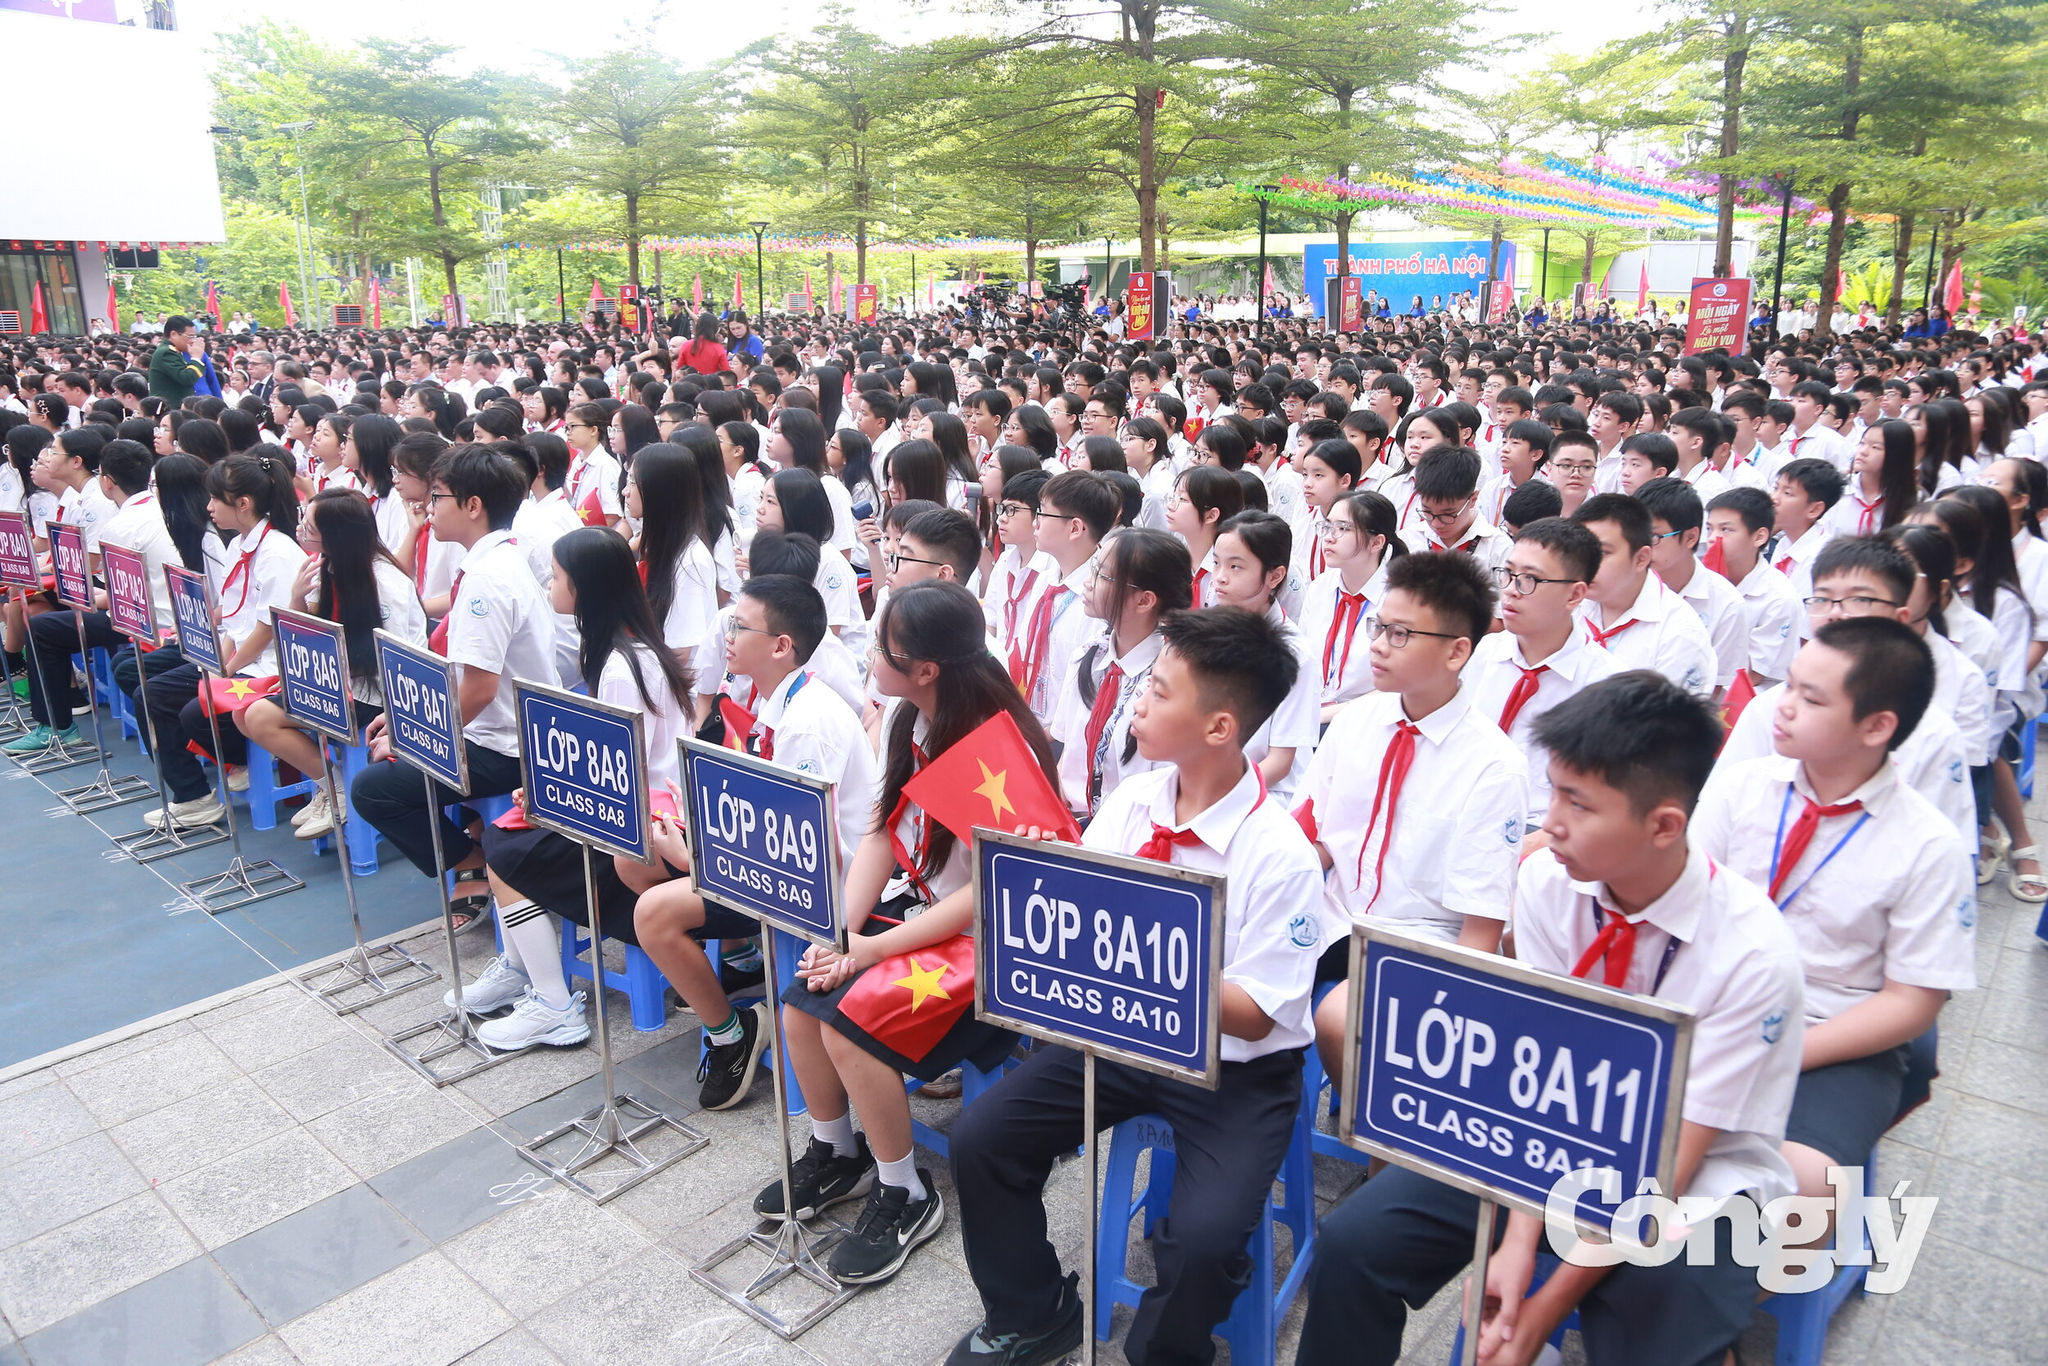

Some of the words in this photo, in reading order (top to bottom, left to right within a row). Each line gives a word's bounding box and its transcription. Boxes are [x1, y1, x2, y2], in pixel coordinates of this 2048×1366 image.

[1384, 251, 1422, 275] PHỐ
[1424, 254, 1450, 275] HÀ
[1452, 252, 1486, 279] NỘI
[1695, 304, 1714, 320] MỖI
[1714, 303, 1740, 318] NGÀY
[1693, 334, 1720, 349] NGÀY
[1720, 334, 1736, 346] VUI
[9, 533, 28, 558] 8A0
[54, 538, 70, 571] LỚP
[70, 545, 86, 575] 8A1
[1, 562, 19, 575] CLASS
[61, 578, 78, 593] CLASS
[110, 561, 129, 598] LỚP
[128, 573, 146, 605] 8A2
[119, 604, 137, 623] CLASS
[175, 585, 194, 625] LỚP
[193, 597, 211, 632] 8A3
[186, 631, 203, 650] CLASS
[203, 639, 215, 655] 8A3
[283, 634, 310, 681] LỚP
[312, 650, 339, 692] 8A6
[293, 688, 322, 711] CLASS
[323, 700, 340, 718] 8A6
[387, 664, 419, 716] LỚP
[421, 684, 448, 732] 8A7
[401, 721, 431, 750] CLASS
[432, 738, 449, 760] 8A7
[533, 717, 580, 777] LỚP
[586, 739, 629, 796] 8A8
[546, 784, 595, 816] CLASS
[598, 804, 626, 828] 8A8
[702, 779, 756, 849] LỚP
[765, 808, 818, 873] 8A9
[716, 855, 773, 895] CLASS
[778, 879, 813, 910] 8A9
[1002, 878, 1081, 960] LỚP
[1093, 909, 1189, 991] 8A10
[1010, 970, 1103, 1015] CLASS
[1111, 996, 1181, 1037] 8A10
[1385, 990, 1497, 1089] LỚP
[1508, 1035, 1642, 1145] 8A11
[1391, 1093, 1514, 1157] CLASS
[1524, 1138, 1616, 1197] 8A11
